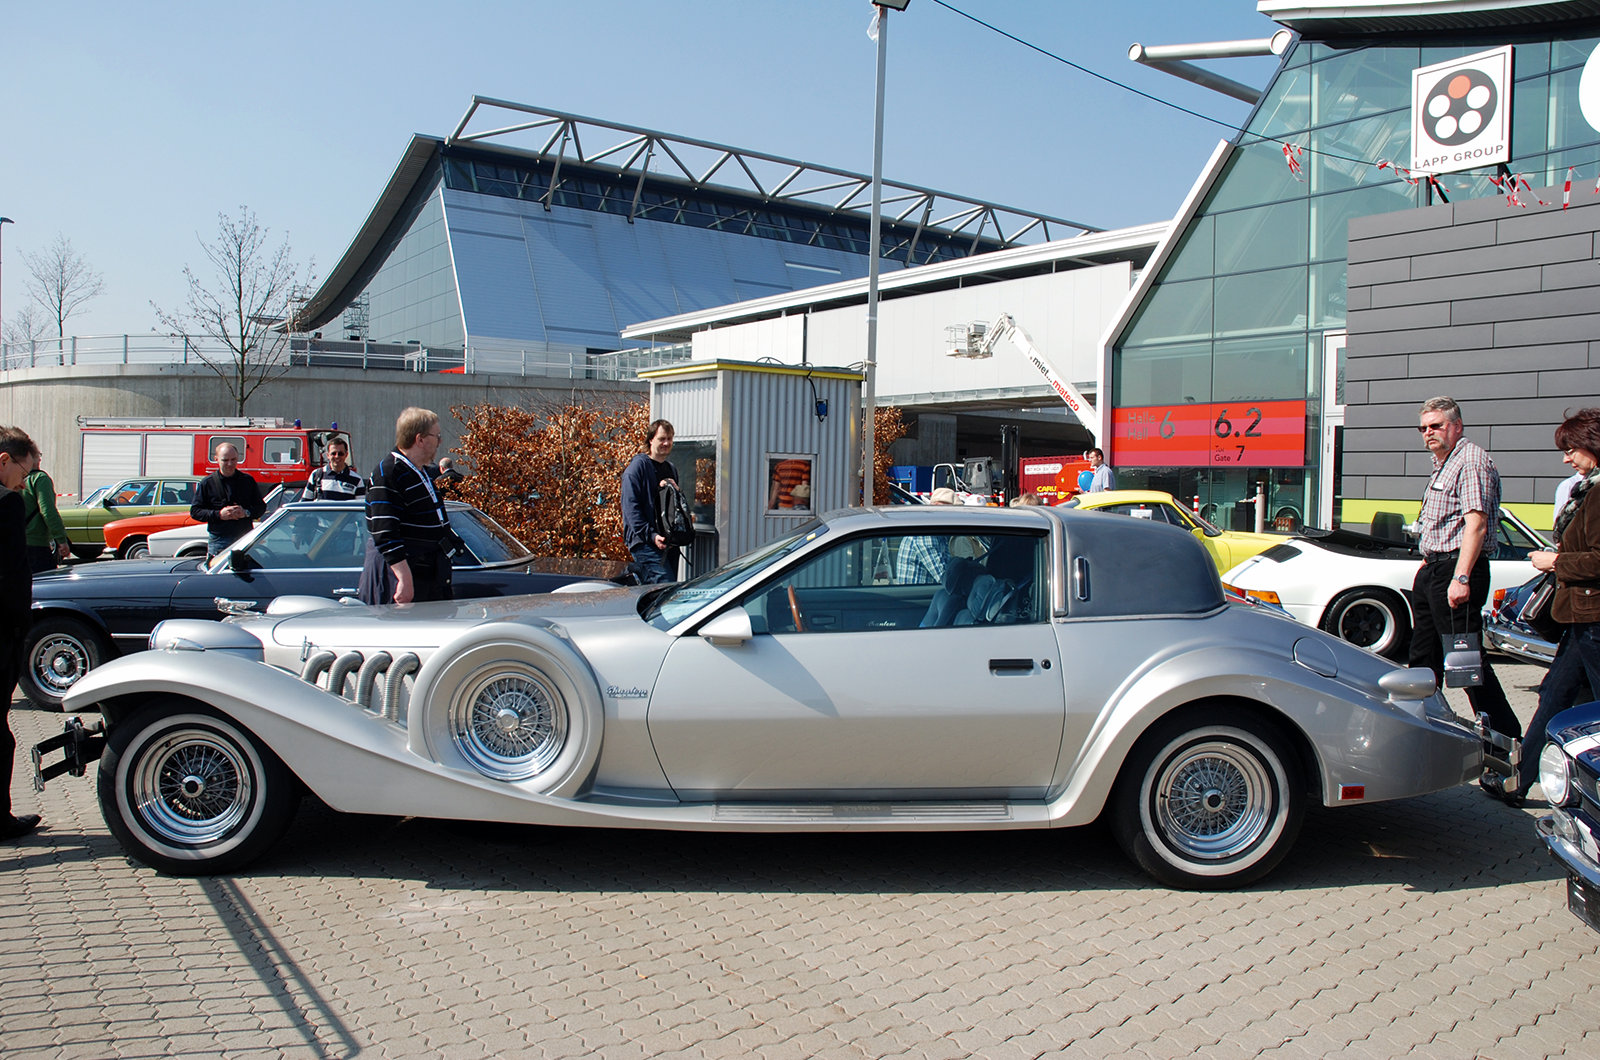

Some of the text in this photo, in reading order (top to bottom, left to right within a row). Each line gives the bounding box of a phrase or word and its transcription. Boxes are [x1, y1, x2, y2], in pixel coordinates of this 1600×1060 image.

[1414, 144, 1505, 170] LAPP GROUP
[1052, 380, 1080, 411] mateco
[1127, 411, 1176, 439] Halle 6
[1127, 428, 1149, 441] Hall
[1214, 407, 1263, 438] 6.2
[1214, 445, 1225, 453] Tor
[1214, 445, 1246, 462] Gate 7
